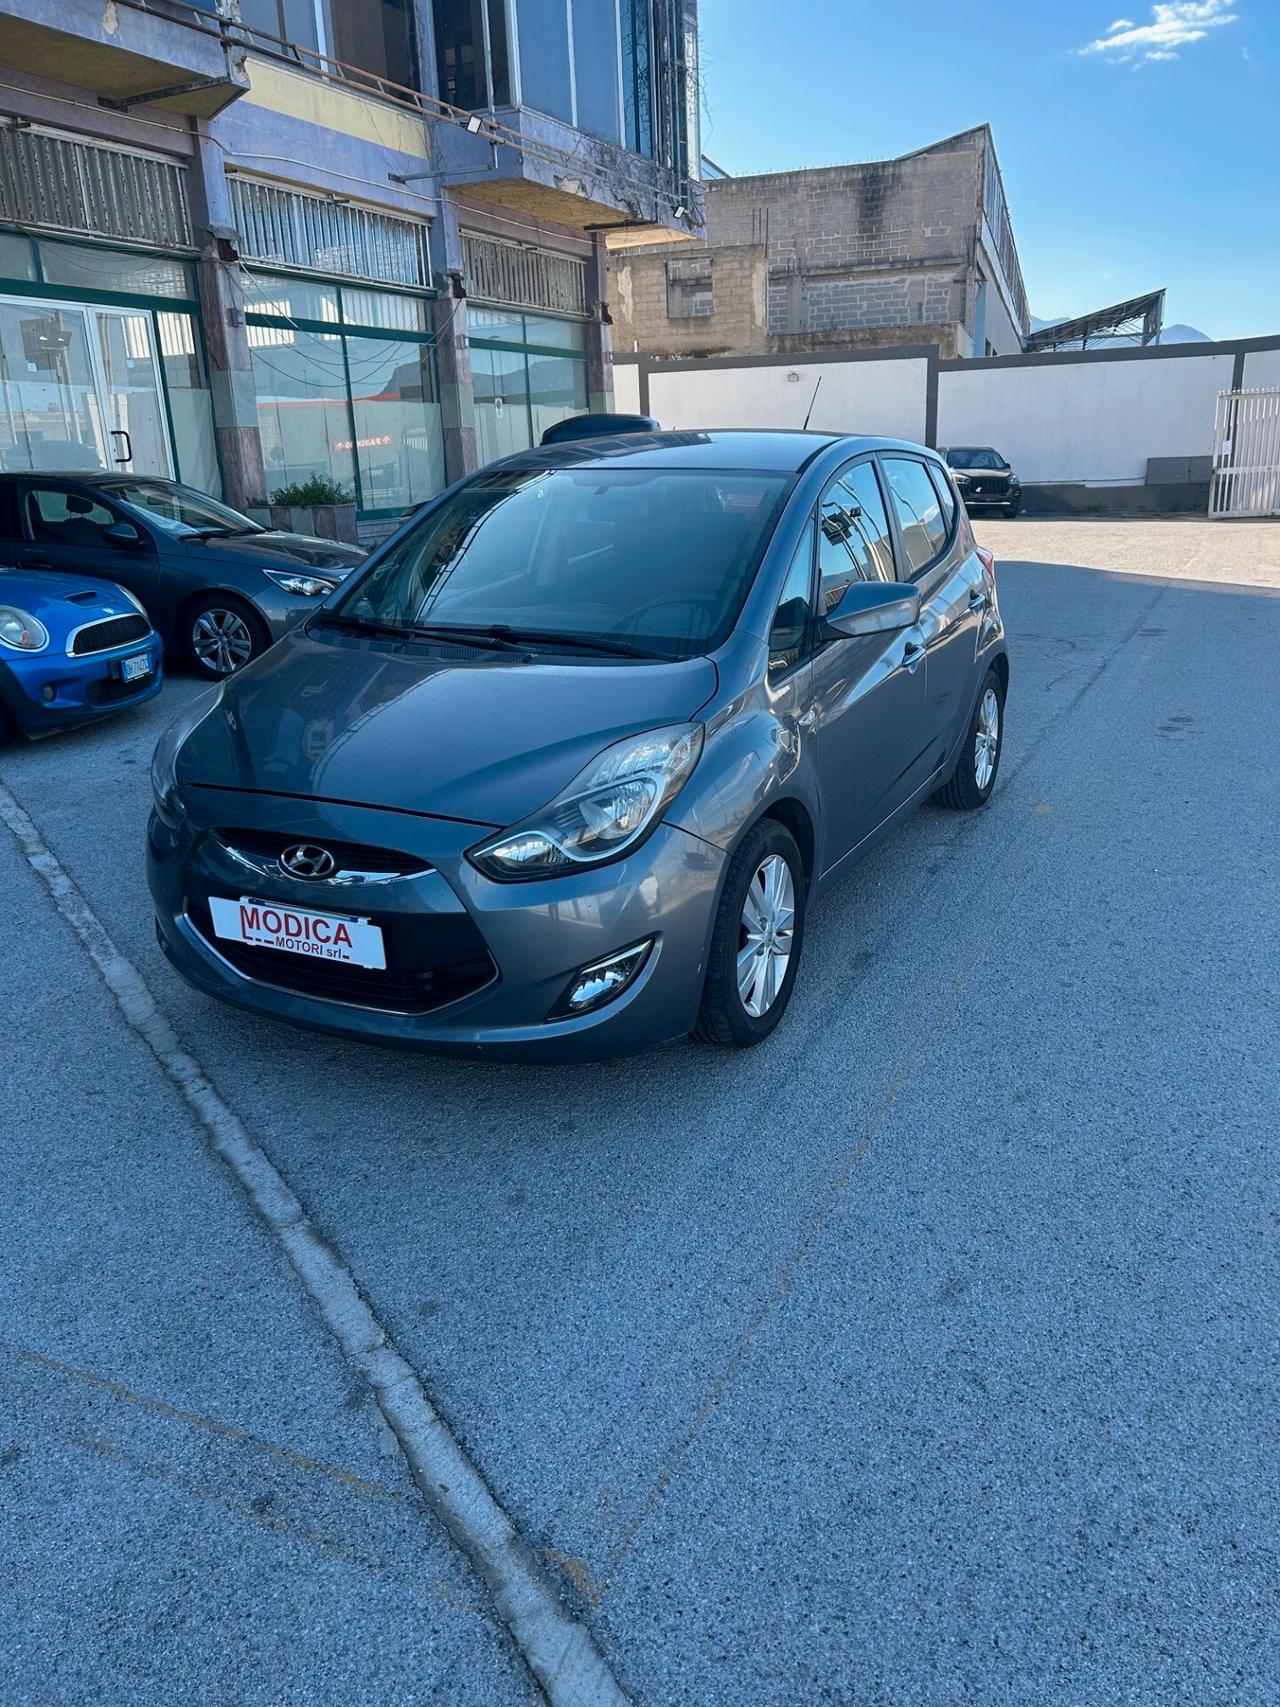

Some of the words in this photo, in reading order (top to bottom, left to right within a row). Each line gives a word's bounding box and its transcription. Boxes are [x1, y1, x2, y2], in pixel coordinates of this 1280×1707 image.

[240, 905, 353, 948] MODICA
[275, 936, 323, 955] MOTORI
[326, 948, 342, 959] srl
